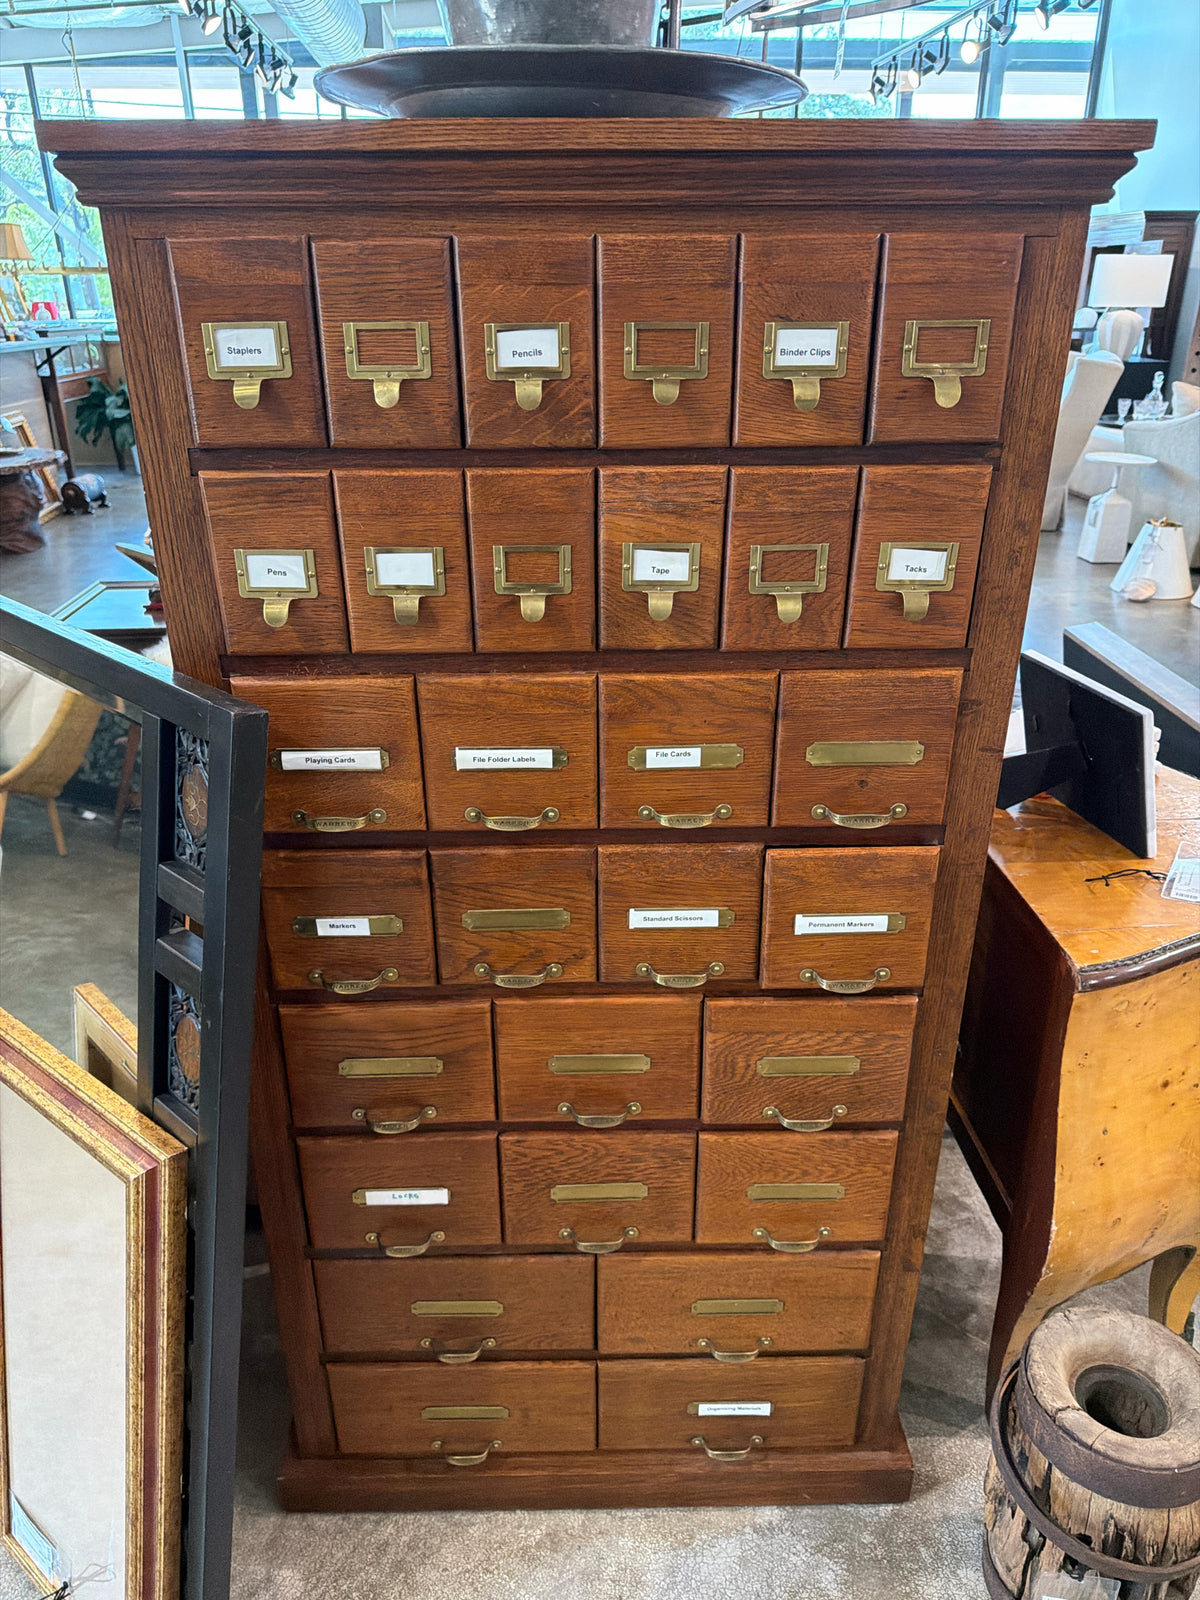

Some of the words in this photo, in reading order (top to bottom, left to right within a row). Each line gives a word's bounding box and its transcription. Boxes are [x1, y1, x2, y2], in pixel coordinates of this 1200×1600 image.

[227, 347, 262, 357] Staplers
[512, 348, 543, 359] Pencils
[780, 347, 809, 357] Binder
[810, 347, 831, 359] Clips
[267, 568, 288, 577] Pens
[651, 566, 670, 576] Tape
[904, 565, 928, 574] Tacks
[671, 750, 692, 758] Cards
[304, 756, 333, 766] Playing
[334, 756, 356, 764] Cards
[488, 755, 511, 763] Folder
[512, 755, 536, 763] Labels
[847, 920, 875, 928] Markers
